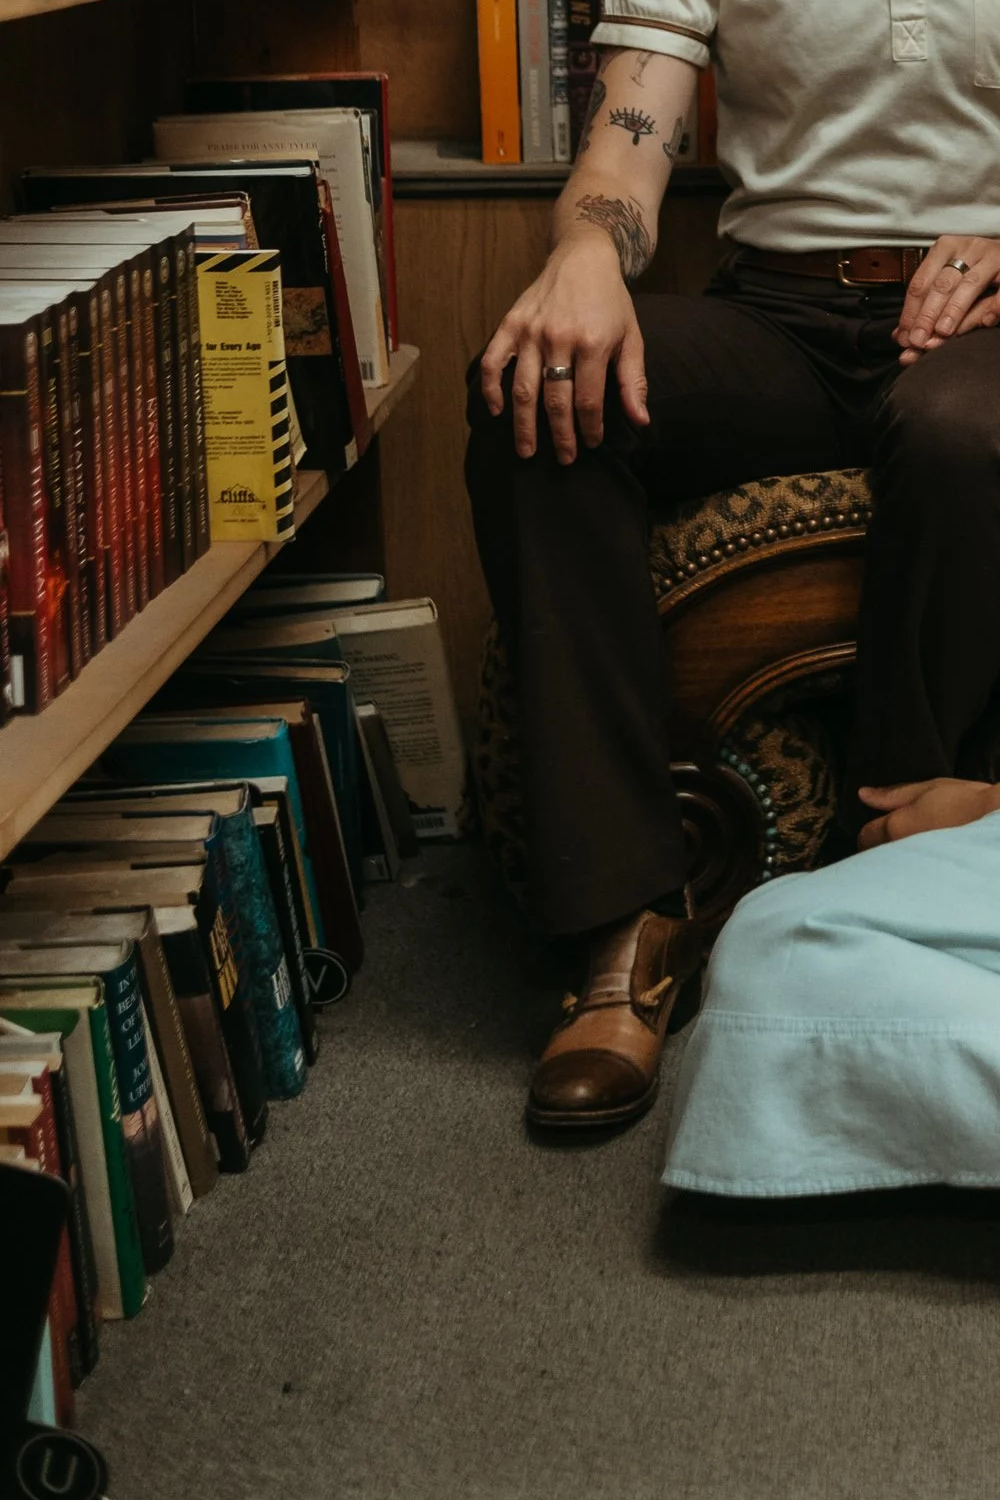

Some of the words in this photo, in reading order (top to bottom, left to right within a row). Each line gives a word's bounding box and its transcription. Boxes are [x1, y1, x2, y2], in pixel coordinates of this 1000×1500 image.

[206, 341, 220, 351] for
[221, 341, 246, 353] Every
[247, 341, 262, 351] Age
[192, 358, 201, 405] CIVIL
[193, 409, 204, 447] WAR
[220, 489, 255, 504] Cliffs
[40, 1448, 79, 1494] U
